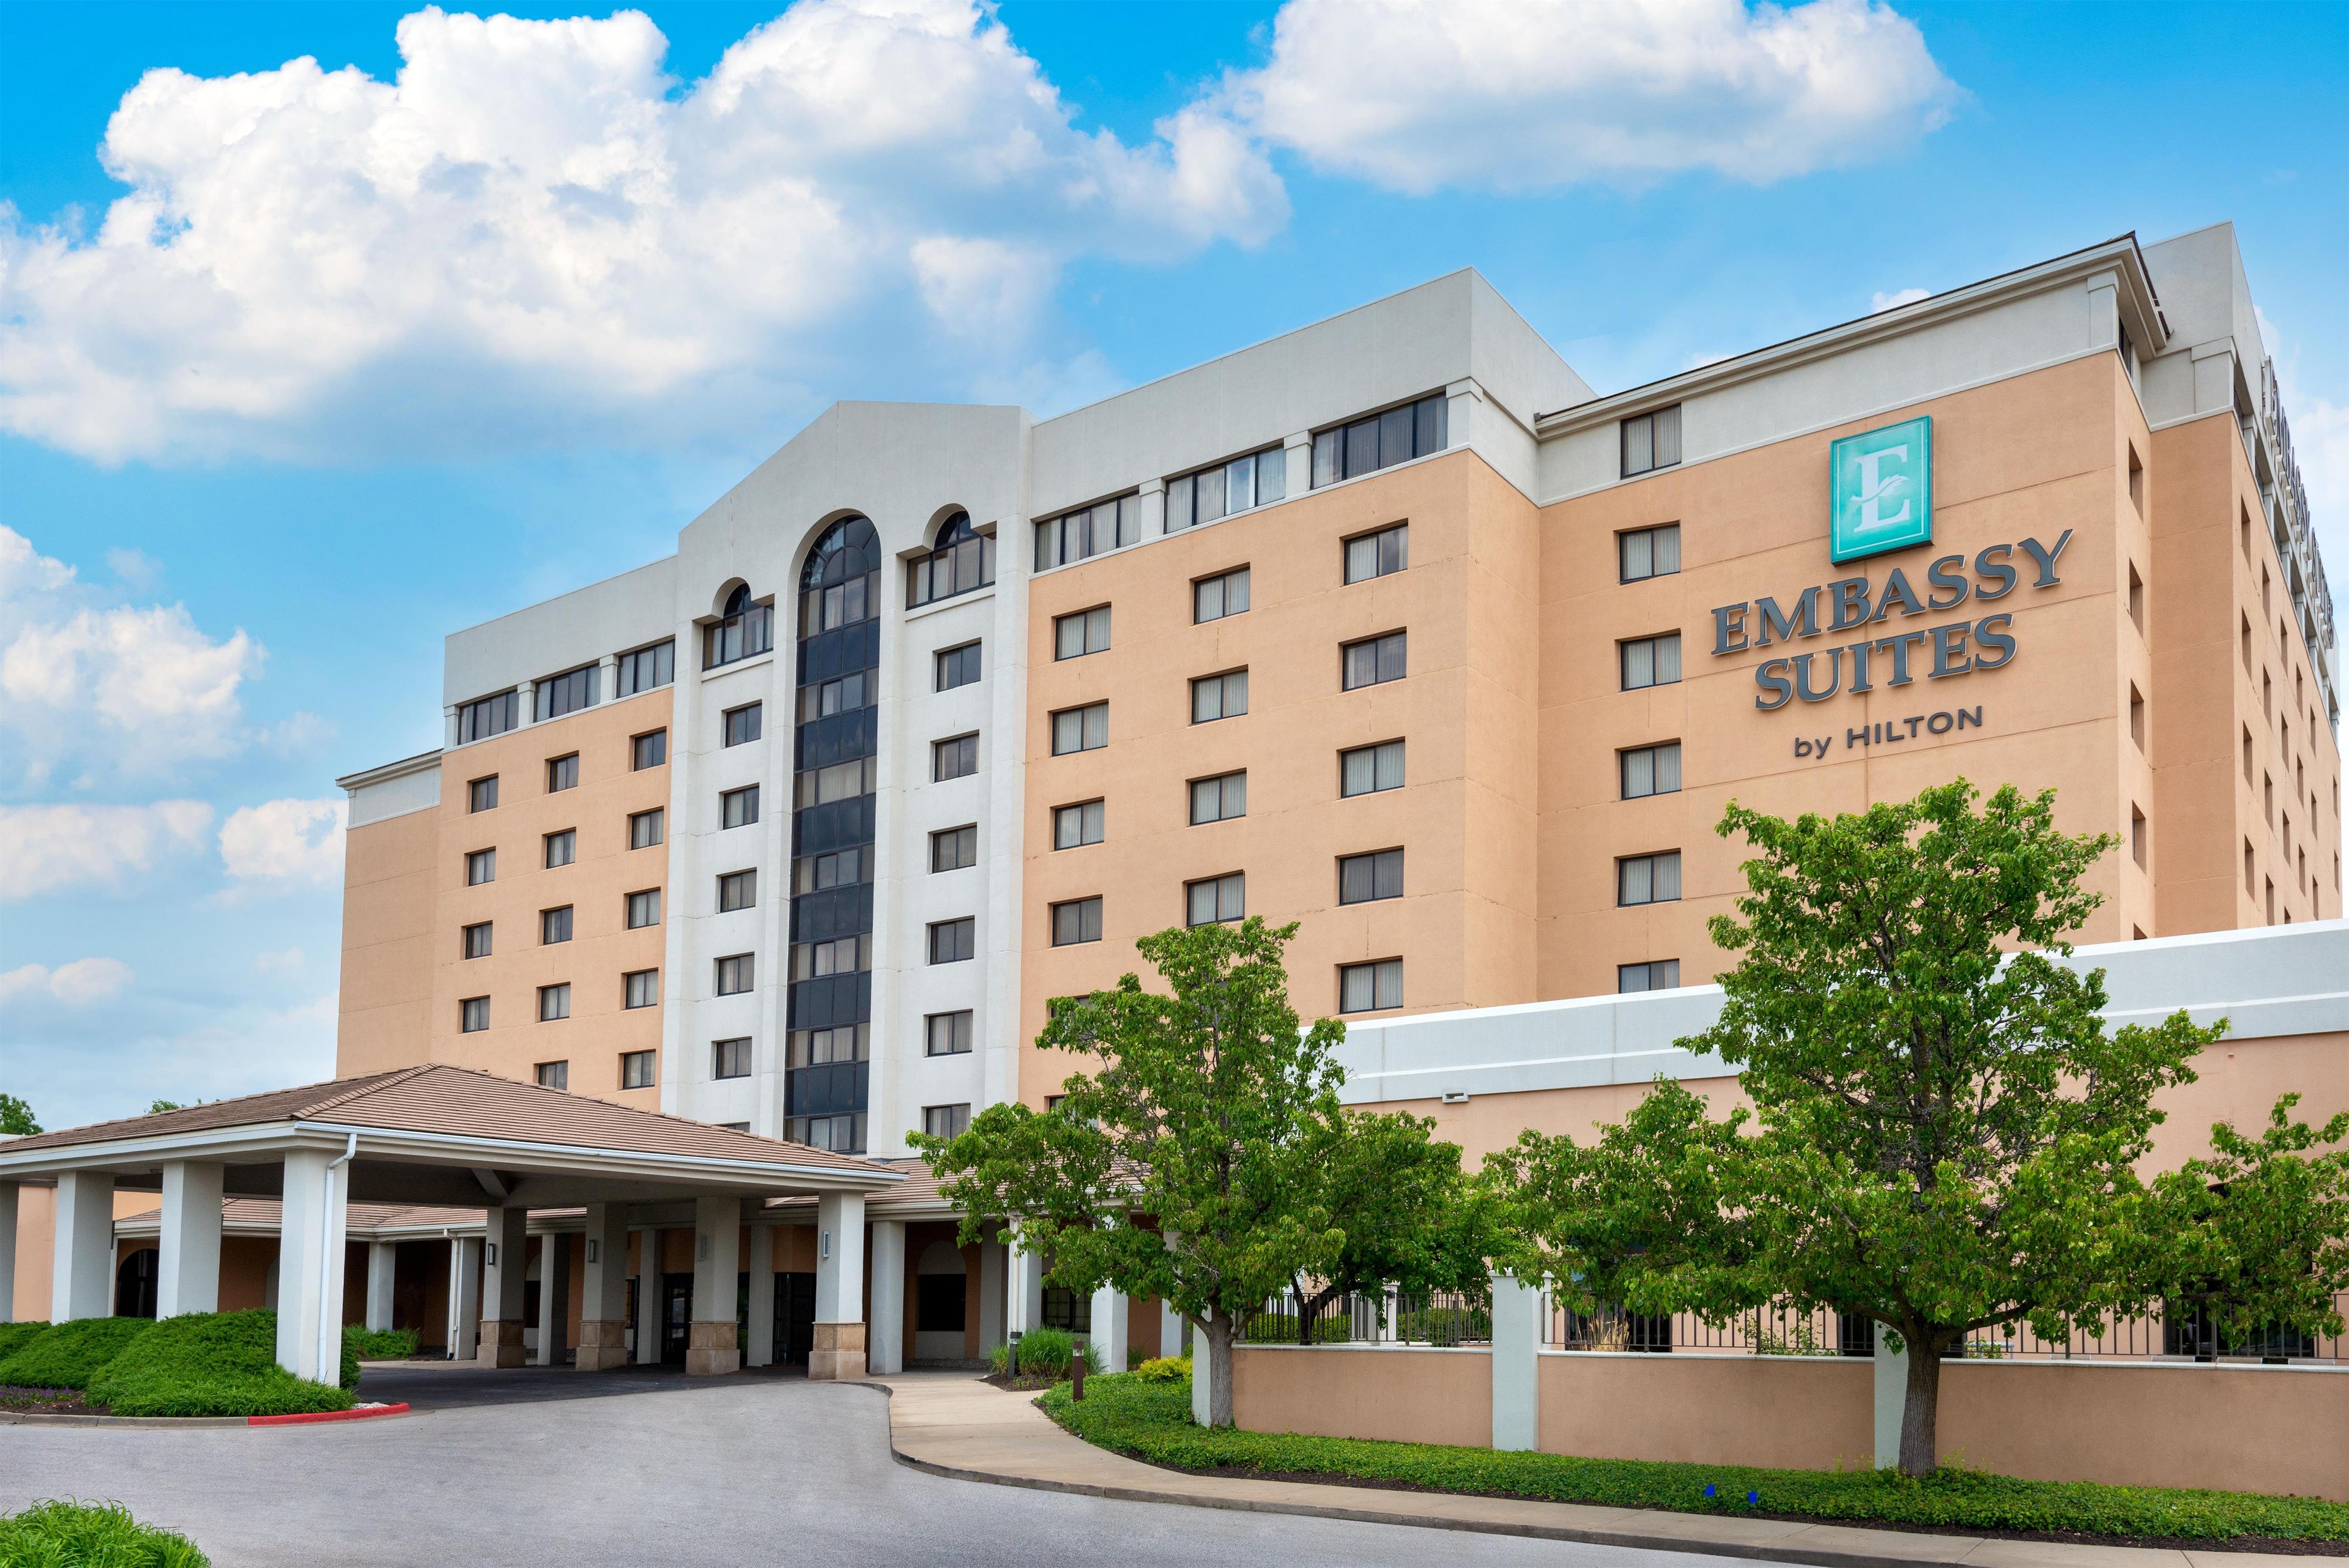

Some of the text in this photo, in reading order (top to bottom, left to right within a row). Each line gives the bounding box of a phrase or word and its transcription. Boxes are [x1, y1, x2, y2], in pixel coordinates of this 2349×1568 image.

[1853, 444, 1910, 533] E
[1710, 529, 2074, 656] EMBASSY
[1755, 614, 2017, 710] SUITES
[1794, 705, 1983, 759] by HILTON
